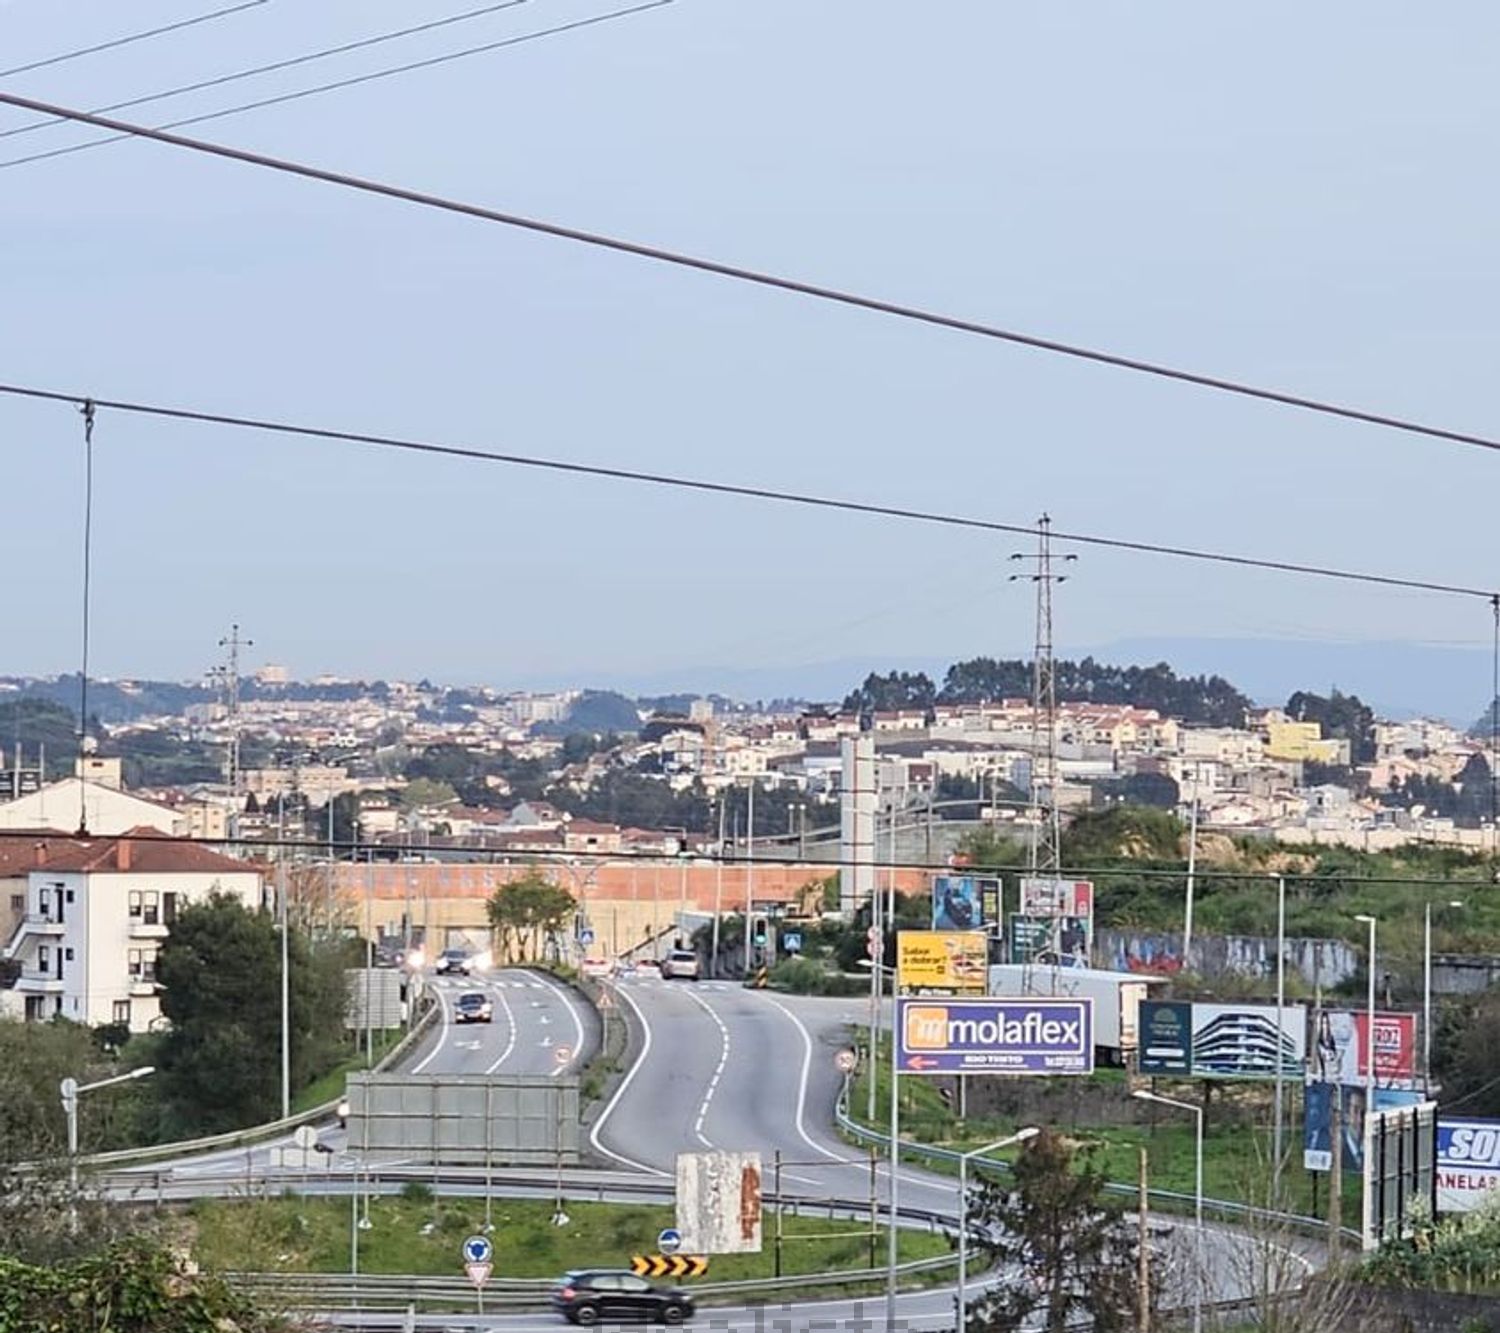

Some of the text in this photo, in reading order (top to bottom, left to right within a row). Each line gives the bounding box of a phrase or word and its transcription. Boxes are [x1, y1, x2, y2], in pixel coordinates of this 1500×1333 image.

[902, 946, 930, 955] Sabor
[948, 1012, 1079, 1044] molaflex
[987, 1055, 1024, 1064] TINTO
